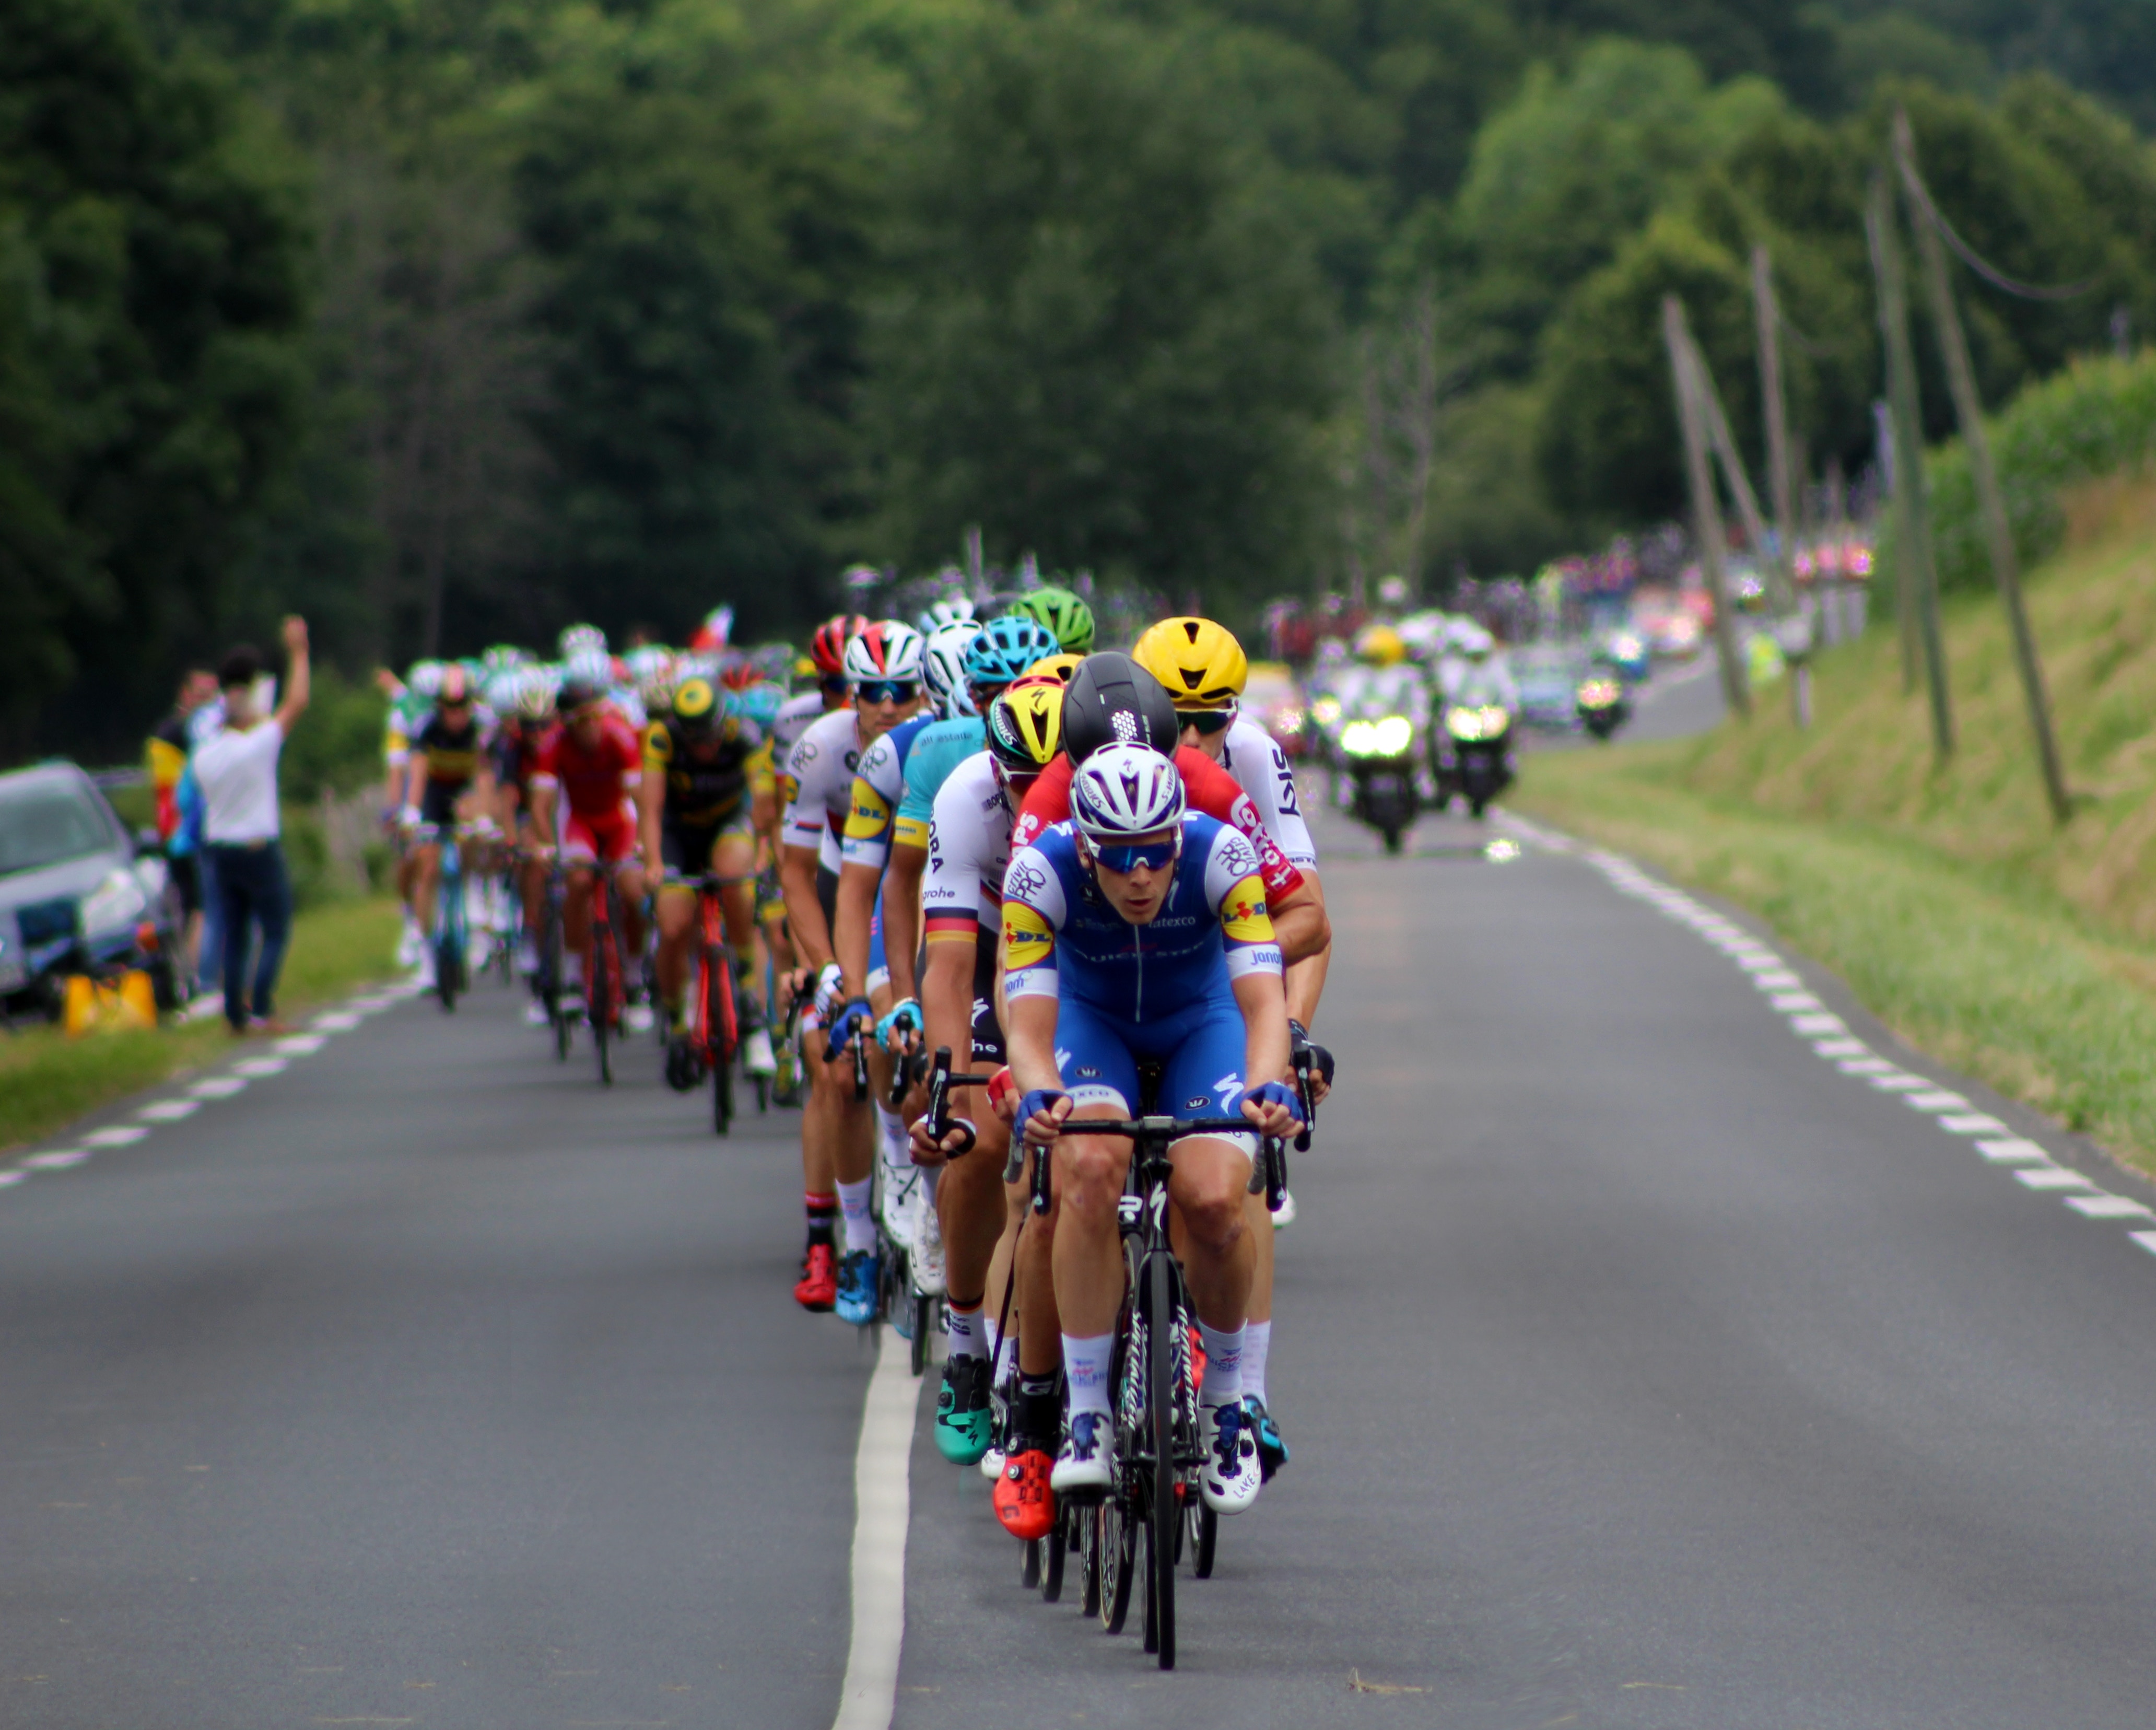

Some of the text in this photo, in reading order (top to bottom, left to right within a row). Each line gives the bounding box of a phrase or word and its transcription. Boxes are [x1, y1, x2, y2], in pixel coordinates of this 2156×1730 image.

[1272, 747, 1301, 817] SKY
[1216, 844, 1249, 876] PRO
[923, 886, 955, 902] grohe
[1014, 868, 1046, 903] PRO
[1233, 1472, 1256, 1499] LAKE
